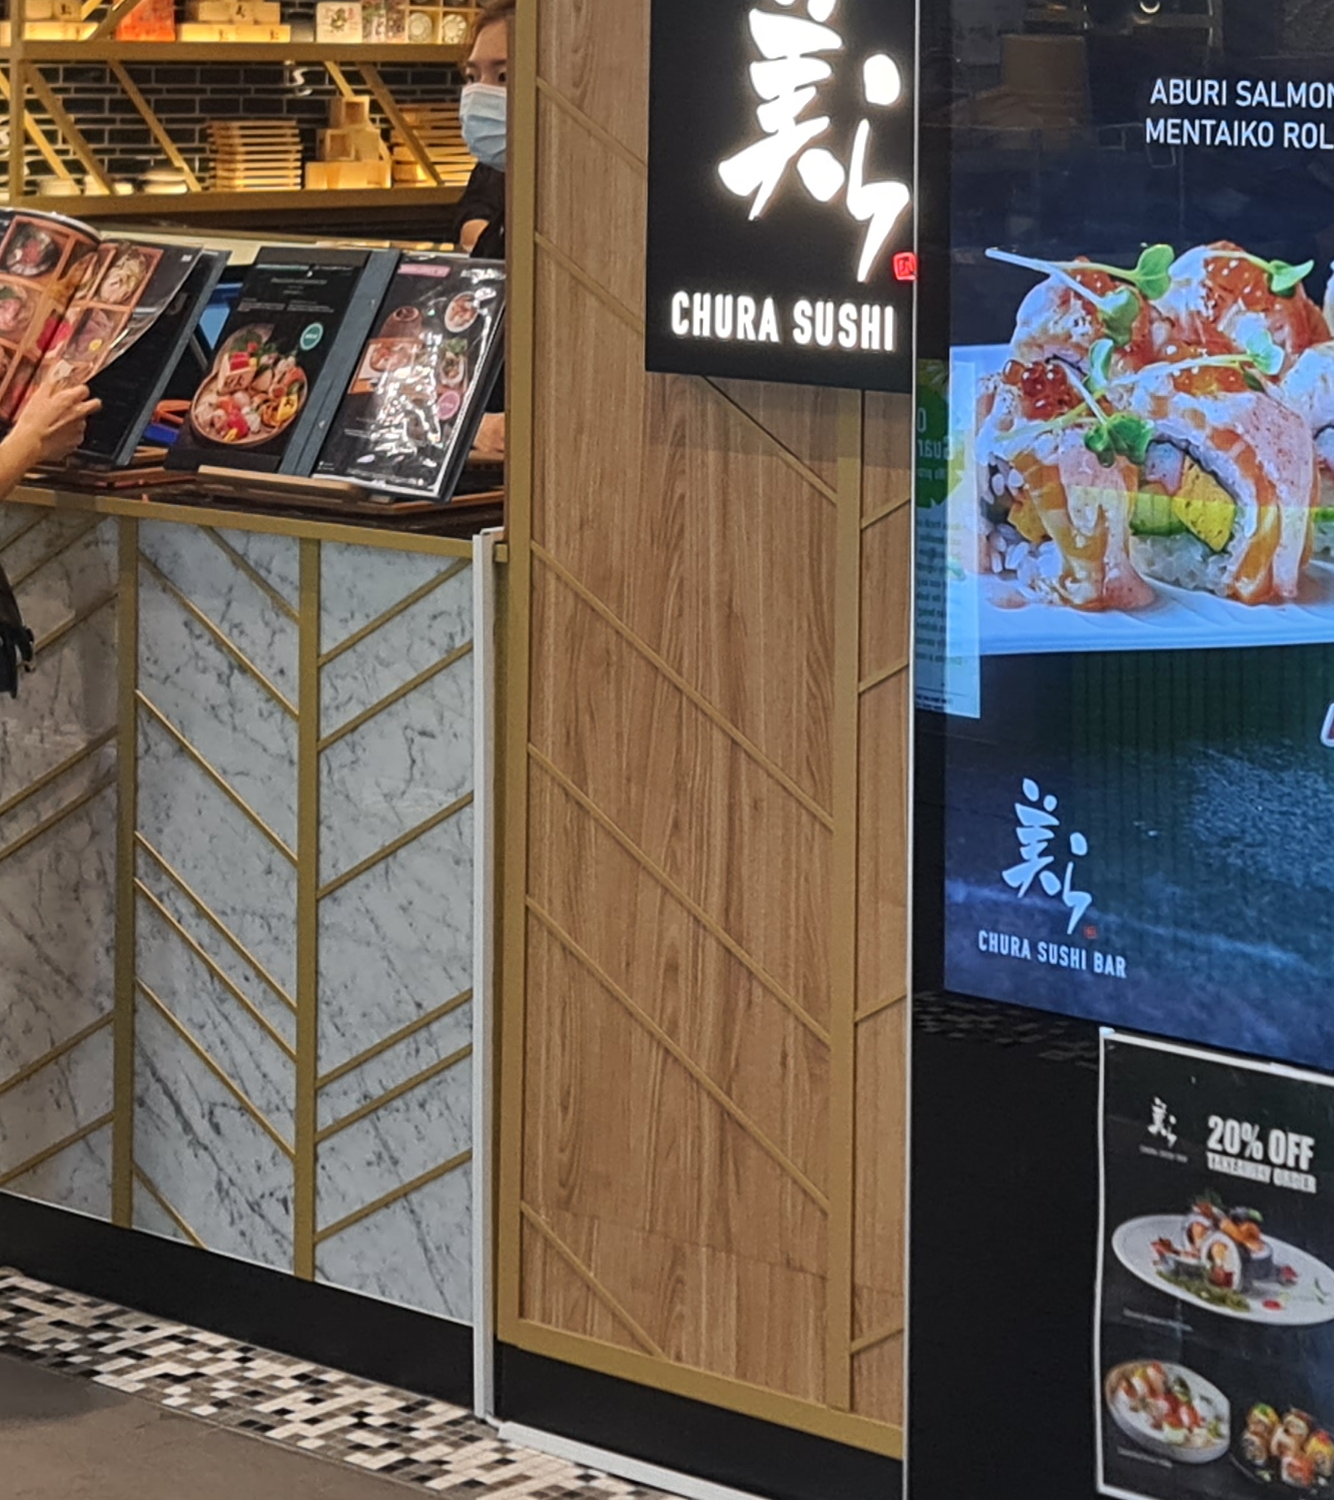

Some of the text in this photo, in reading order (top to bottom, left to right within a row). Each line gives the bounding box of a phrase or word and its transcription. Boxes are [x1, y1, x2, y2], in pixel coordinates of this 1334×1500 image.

[1150, 78, 1229, 109] ABURI
[1145, 117, 1275, 149] MENTAIKO
[670, 291, 896, 353] CHURA SUSHI
[978, 930, 1127, 979] CHURA SUSHI BAR
[1207, 1115, 1264, 1161] 20%
[1268, 1128, 1316, 1171] OFF
